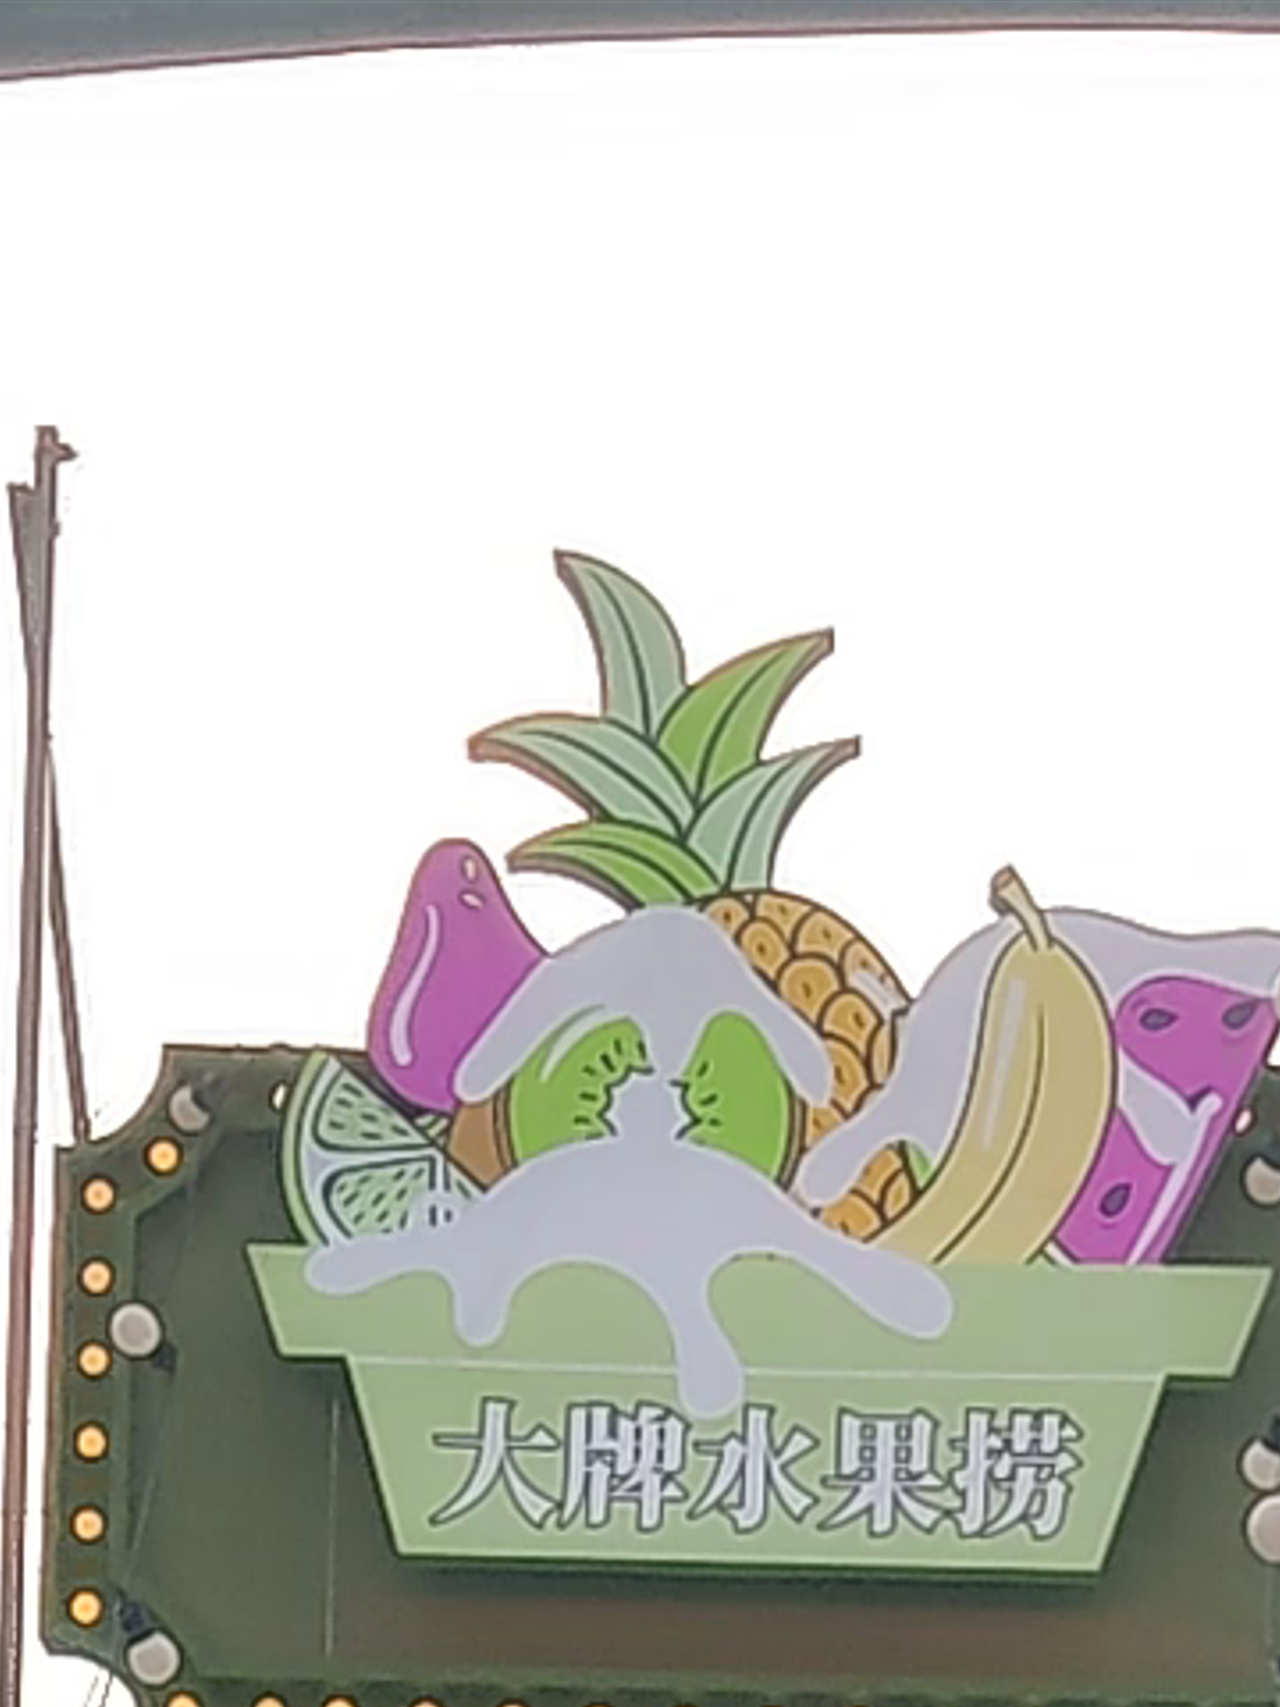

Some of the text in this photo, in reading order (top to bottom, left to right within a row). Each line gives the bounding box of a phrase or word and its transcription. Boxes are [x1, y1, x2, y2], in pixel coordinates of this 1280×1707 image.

[428, 1396, 1084, 1540] 大牌水果捞
